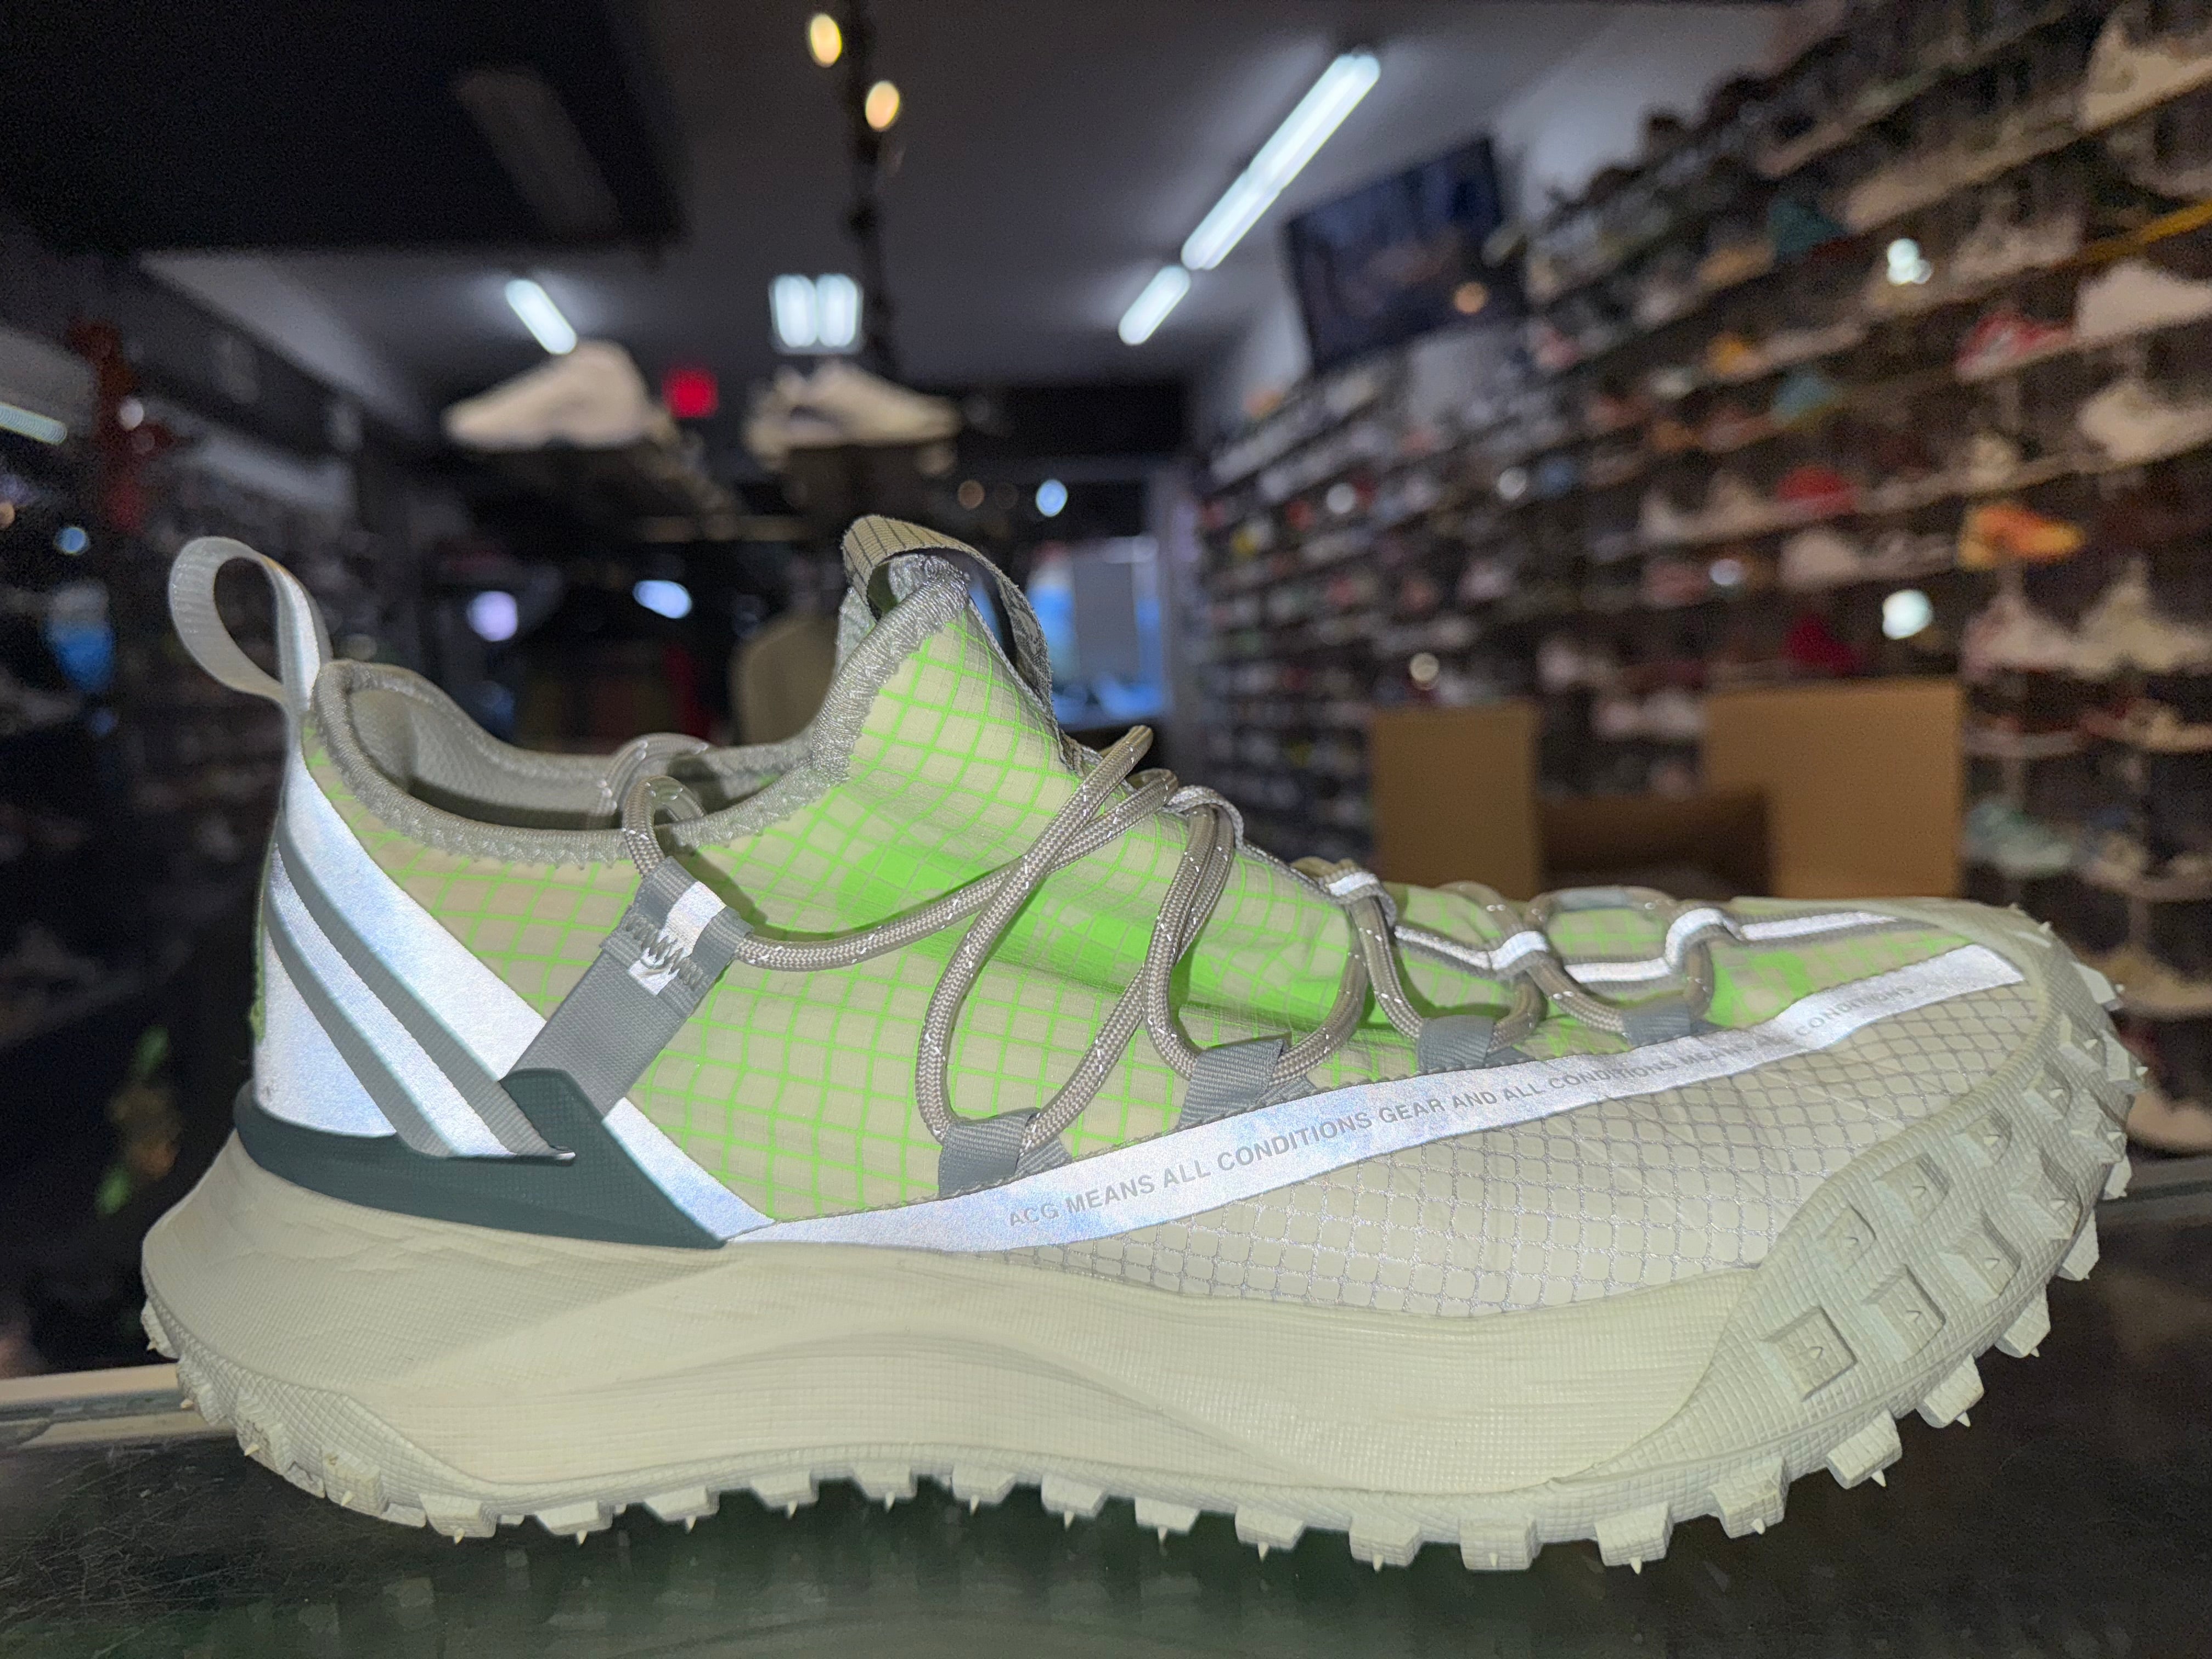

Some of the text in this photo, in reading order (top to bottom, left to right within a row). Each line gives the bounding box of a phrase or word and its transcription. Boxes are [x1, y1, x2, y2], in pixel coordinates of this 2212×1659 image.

[1009, 1202, 1059, 1226] ACG
[1065, 1175, 1155, 1214] MEANS
[1163, 1160, 1211, 1188] ALL
[1217, 1111, 1372, 1171] CONDITIONS
[1379, 1098, 1446, 1123] GEAR
[1452, 1091, 1497, 1109] AND
[1503, 1083, 1545, 1102] ALL
[1548, 1060, 1678, 1090] CONDITIONS
